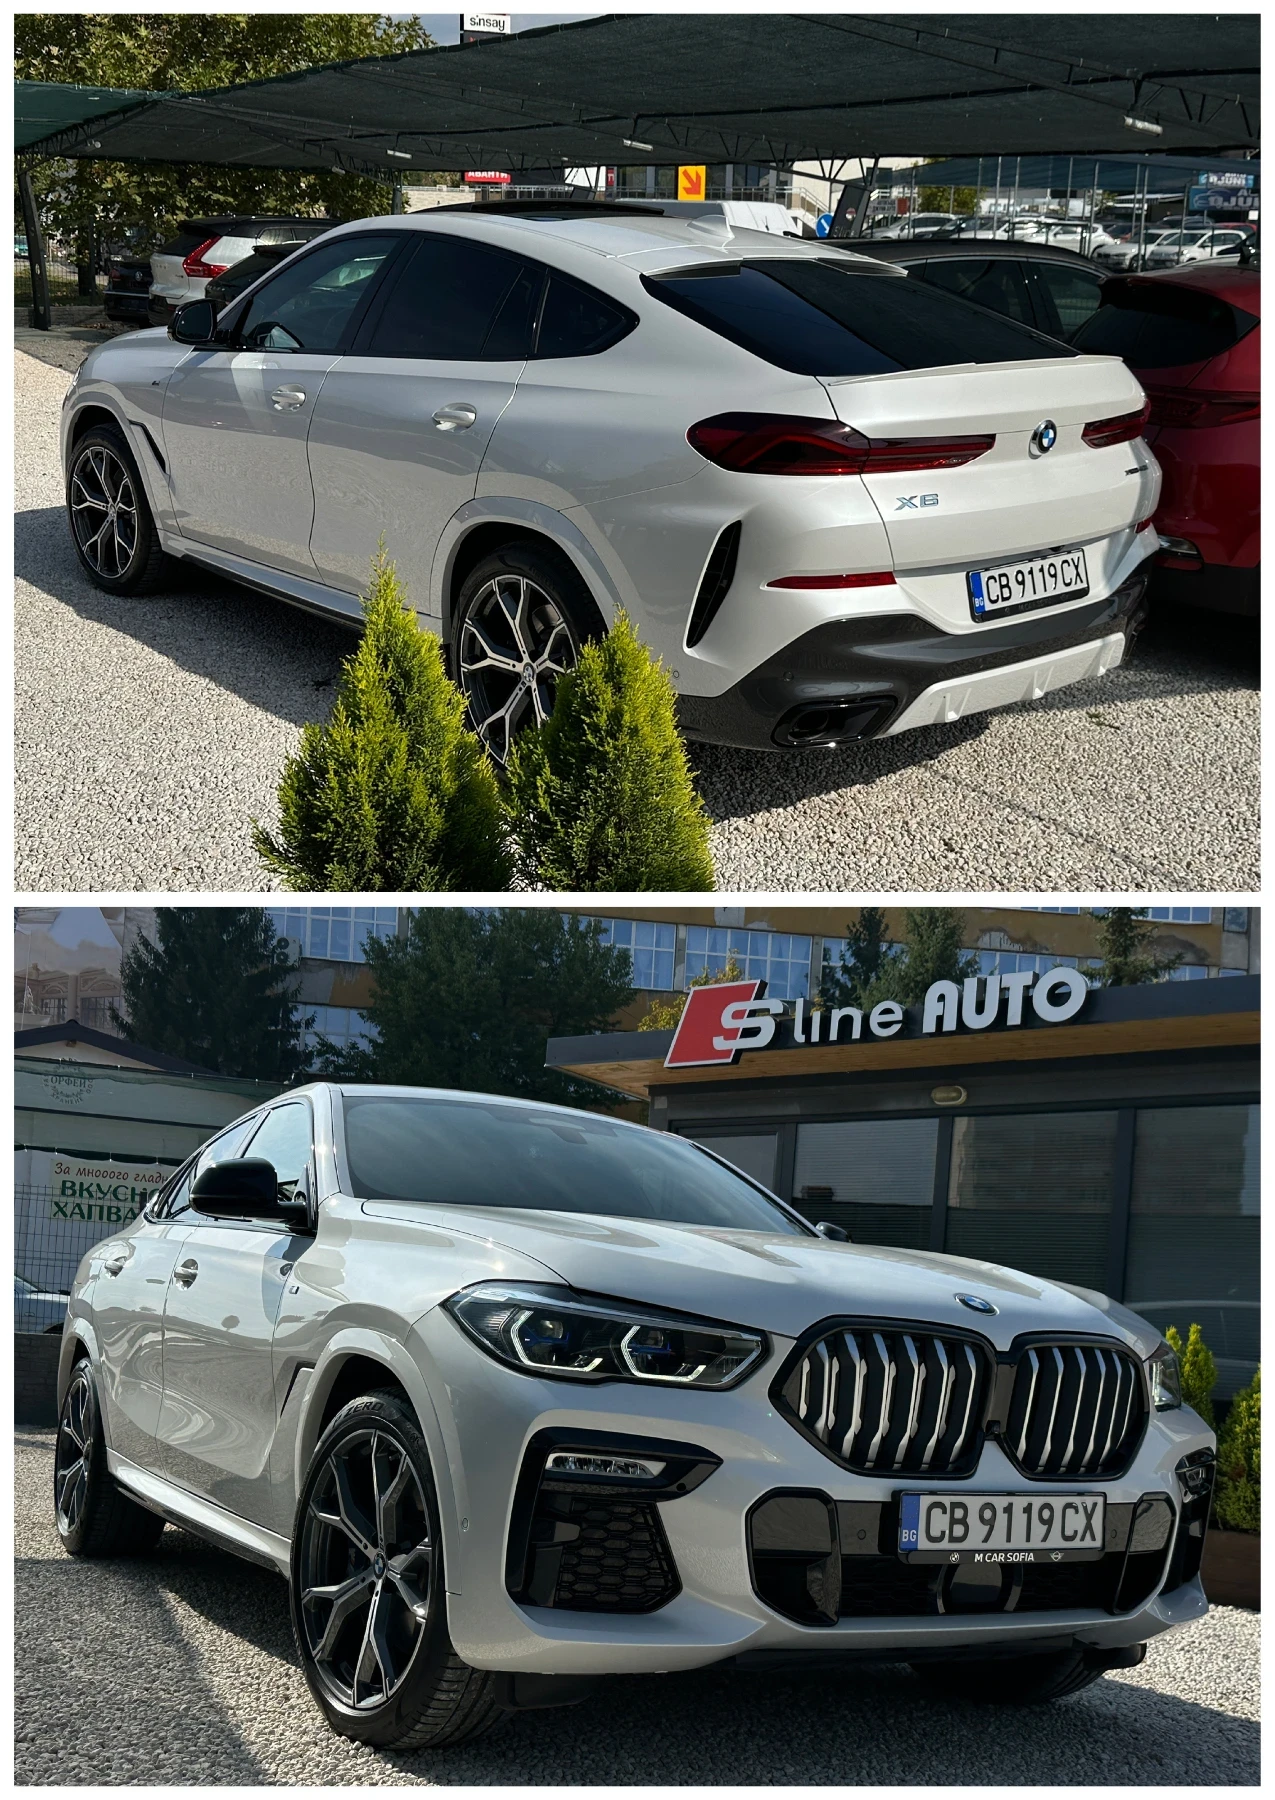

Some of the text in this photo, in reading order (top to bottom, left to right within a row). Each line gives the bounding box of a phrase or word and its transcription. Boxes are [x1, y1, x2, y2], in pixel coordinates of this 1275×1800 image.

[469, 14, 505, 31] sinsay
[893, 493, 939, 511] X6
[986, 572, 1012, 604] CB
[1014, 563, 1058, 598] 9119
[1060, 556, 1084, 587] CX
[975, 597, 984, 607] BG
[793, 997, 903, 1044] line
[922, 966, 1087, 1034] AUTO
[54, 1162, 71, 1175] За
[75, 1167, 129, 1181] мнооого
[924, 1501, 1098, 1544] CB 9119 CX
[902, 1529, 917, 1542] BG
[974, 1552, 1035, 1563] M CAR SOFIA
